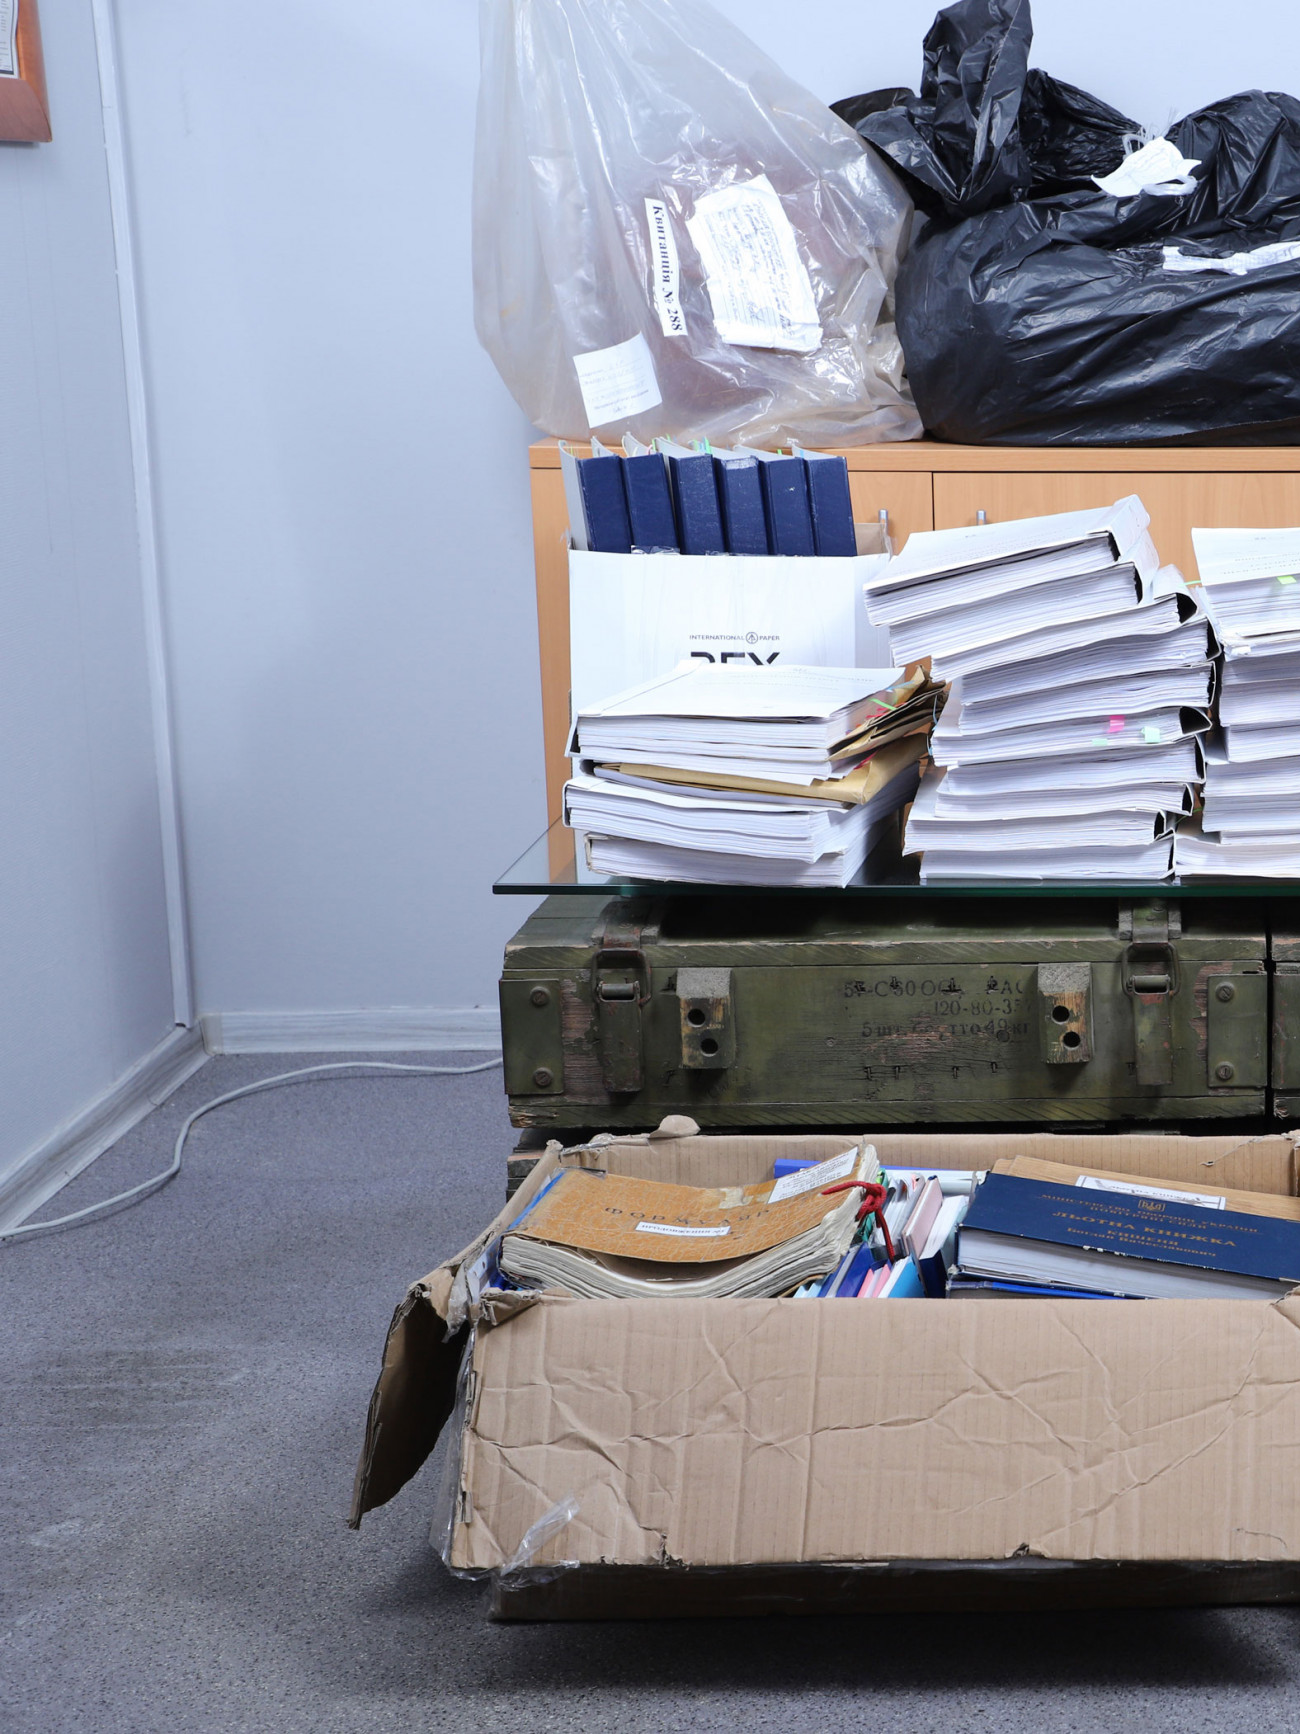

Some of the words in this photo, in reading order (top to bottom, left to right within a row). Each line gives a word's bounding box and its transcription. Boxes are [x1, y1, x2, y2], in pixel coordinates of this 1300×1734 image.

[652, 205, 674, 283] Квитанція
[662, 287, 674, 305] №
[667, 308, 683, 332] 288
[861, 1022, 873, 1037] 5
[1052, 1211, 1136, 1231] ЛЬОТНА
[1143, 1226, 1238, 1248] КНИЖКА
